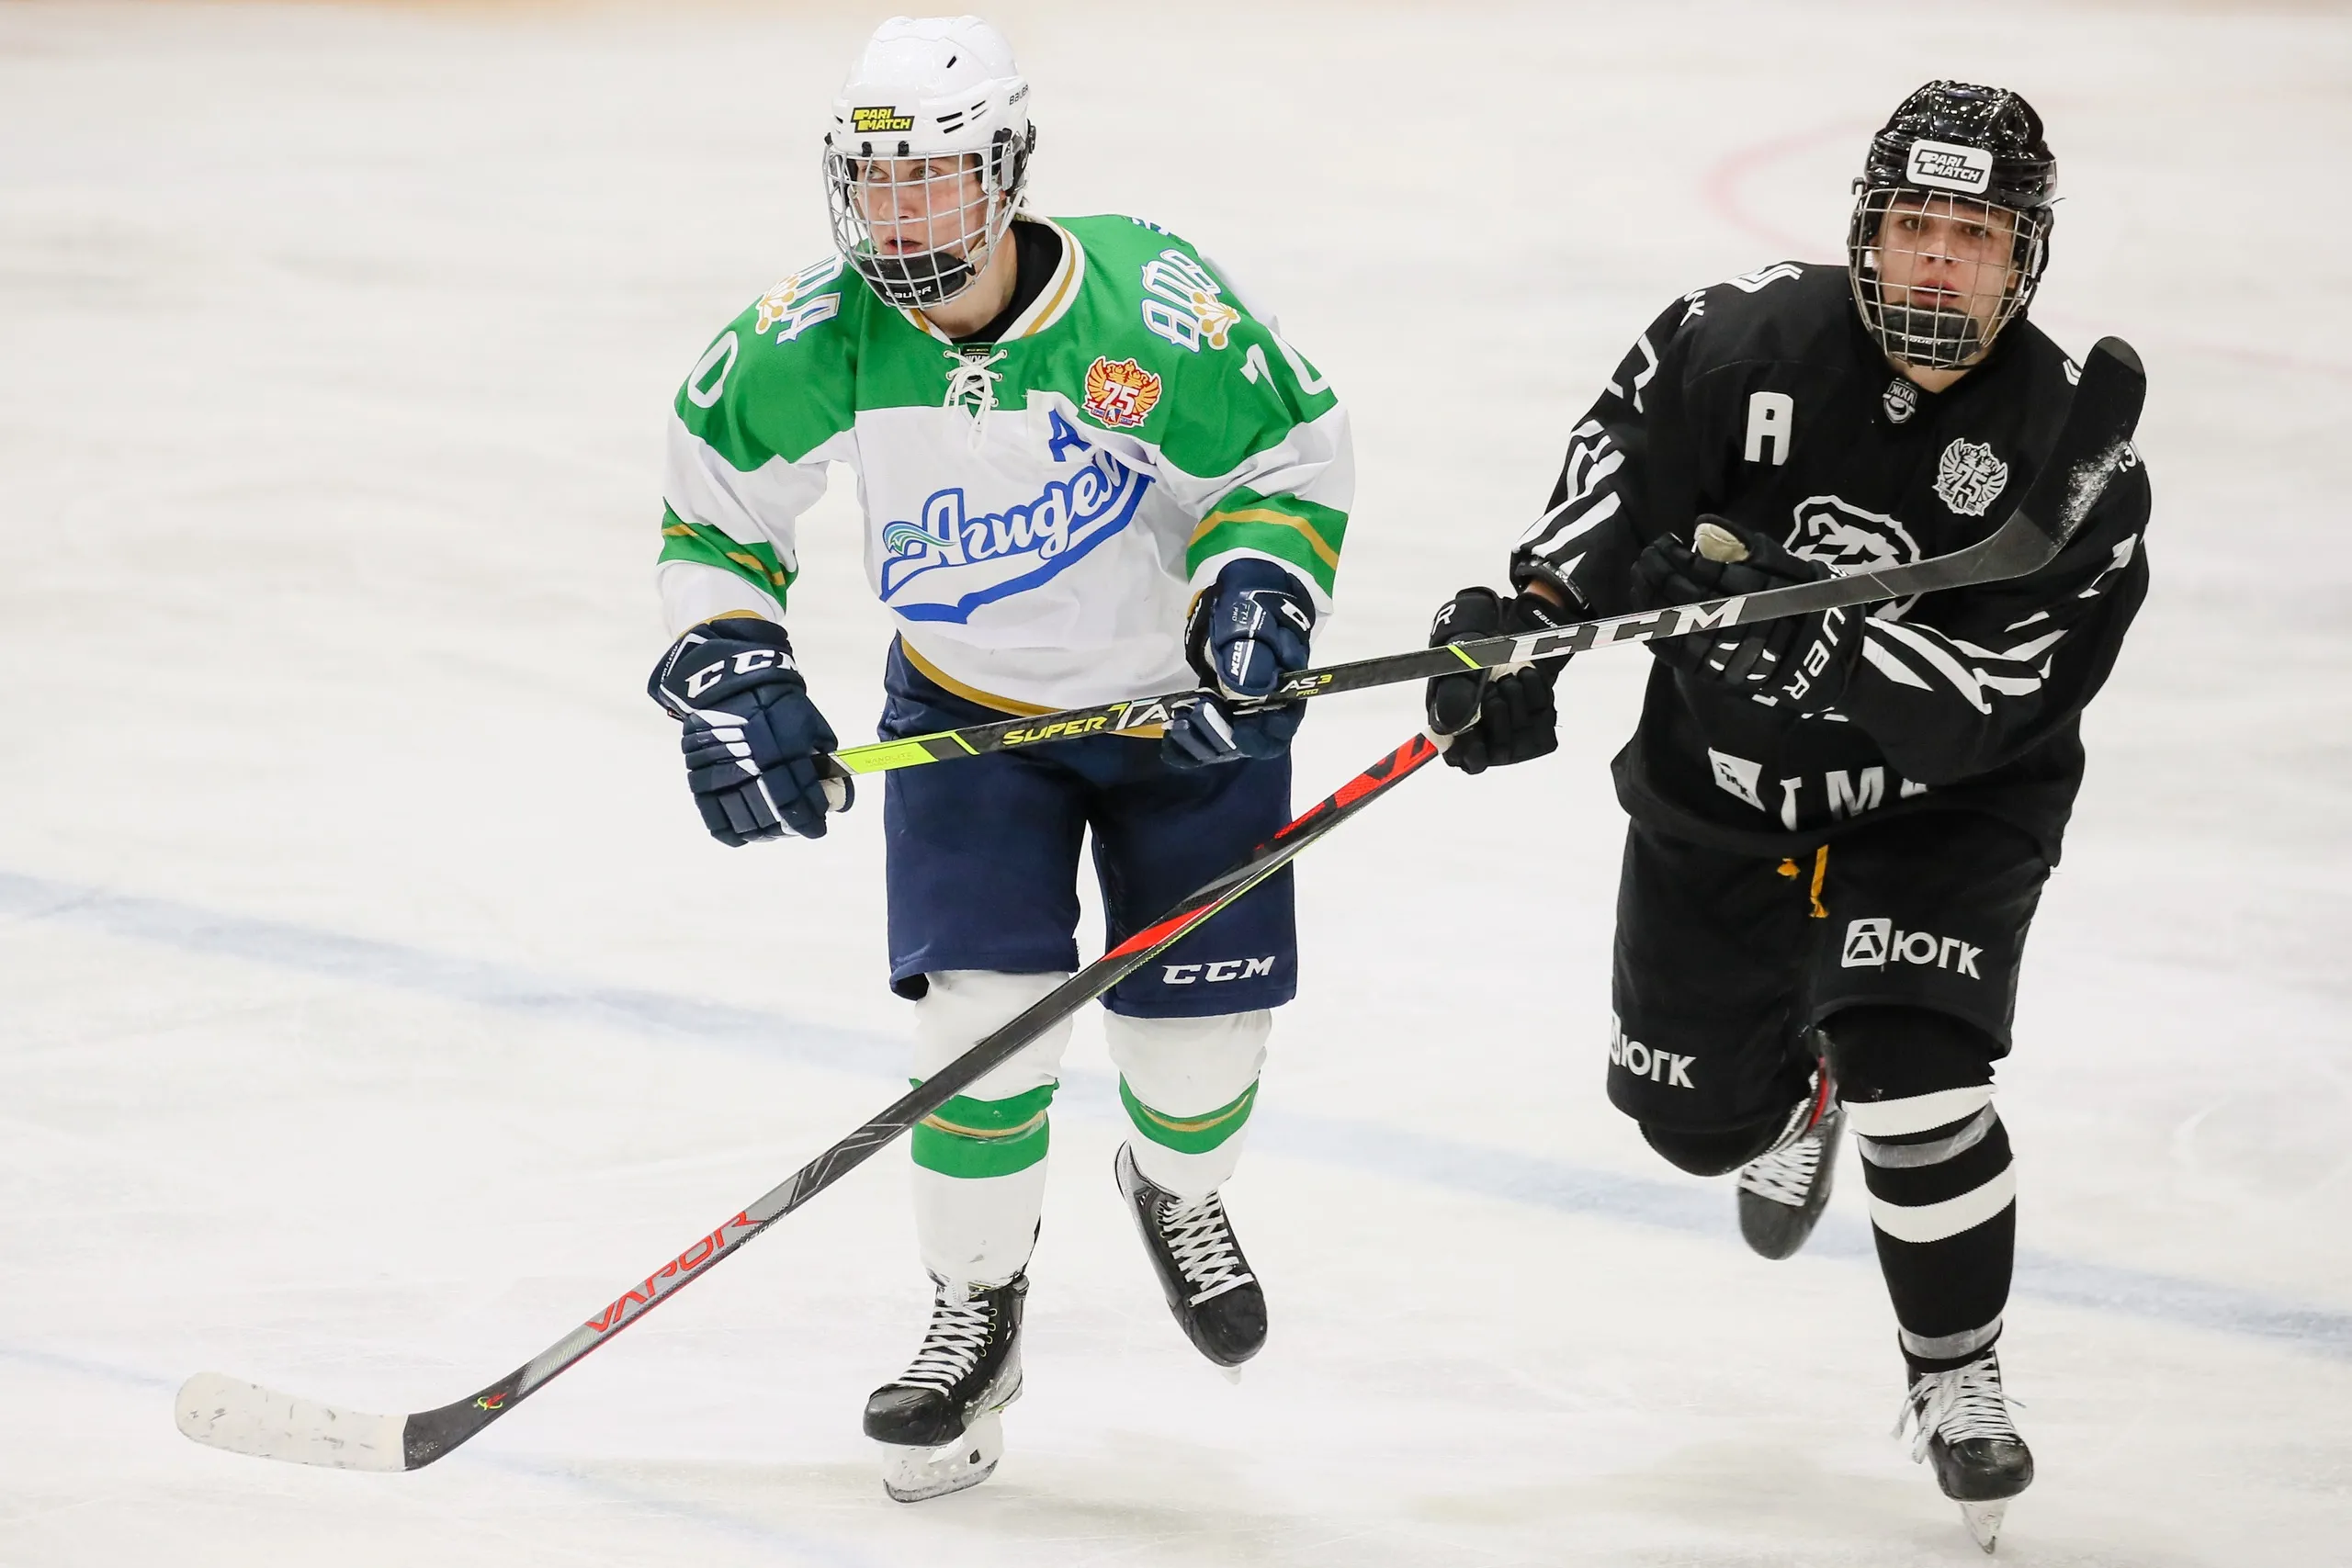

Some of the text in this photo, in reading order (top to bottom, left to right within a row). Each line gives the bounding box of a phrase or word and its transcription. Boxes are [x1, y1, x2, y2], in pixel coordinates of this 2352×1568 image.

[854, 108, 892, 119] PARI
[858, 118, 910, 131] MATCH
[1919, 151, 1963, 166] PARI
[1923, 163, 1981, 182] MATCH
[1099, 379, 1140, 416] 75
[1950, 462, 1989, 503] 75
[1508, 596, 1747, 663] CCM
[1230, 640, 1244, 677] CCM
[1161, 955, 1276, 985] CCM
[1890, 930, 1984, 980] ЮГК
[1620, 1033, 1697, 1089] ЮГК
[584, 1210, 766, 1333] VAPOR
